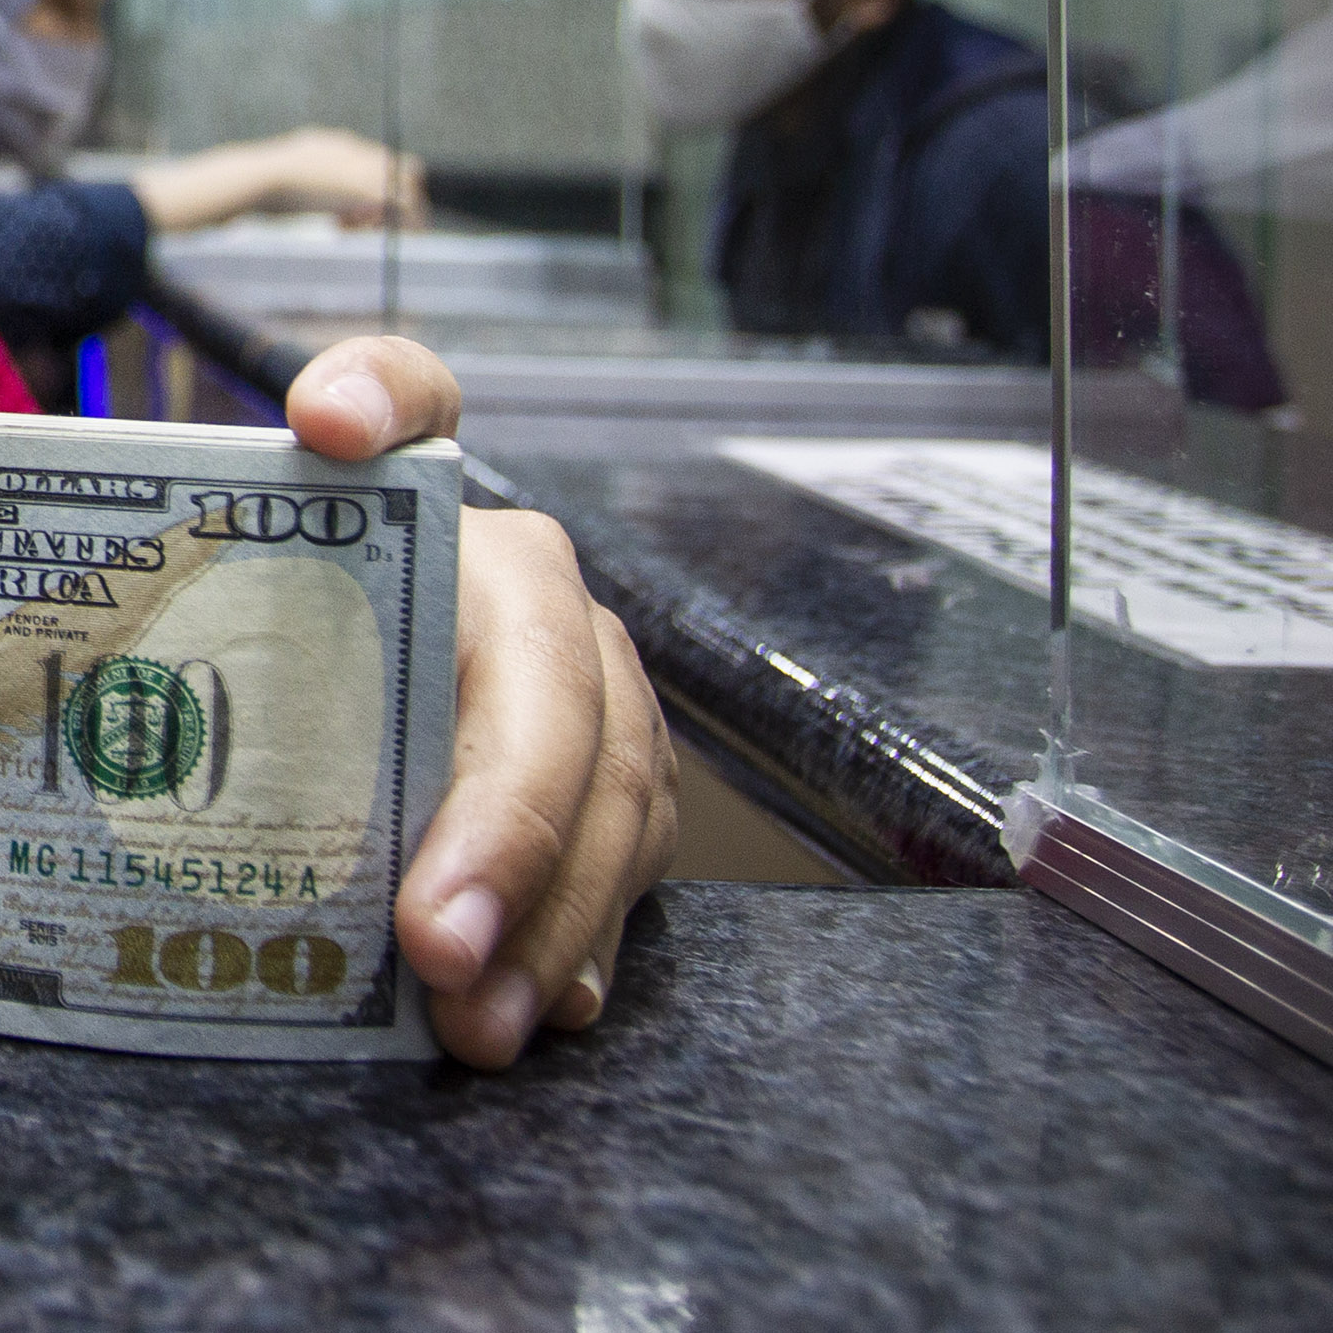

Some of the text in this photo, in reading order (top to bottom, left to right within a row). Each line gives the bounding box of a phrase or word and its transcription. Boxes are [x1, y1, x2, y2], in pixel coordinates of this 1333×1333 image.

[189, 491, 367, 547] 100
[4, 625, 31, 637] AND
[36, 628, 89, 642] PRIVATE
[7, 614, 59, 627] TENDER
[10, 840, 317, 898] MG 11545124 A
[20, 919, 67, 936] SERIES
[104, 925, 348, 994] 100
